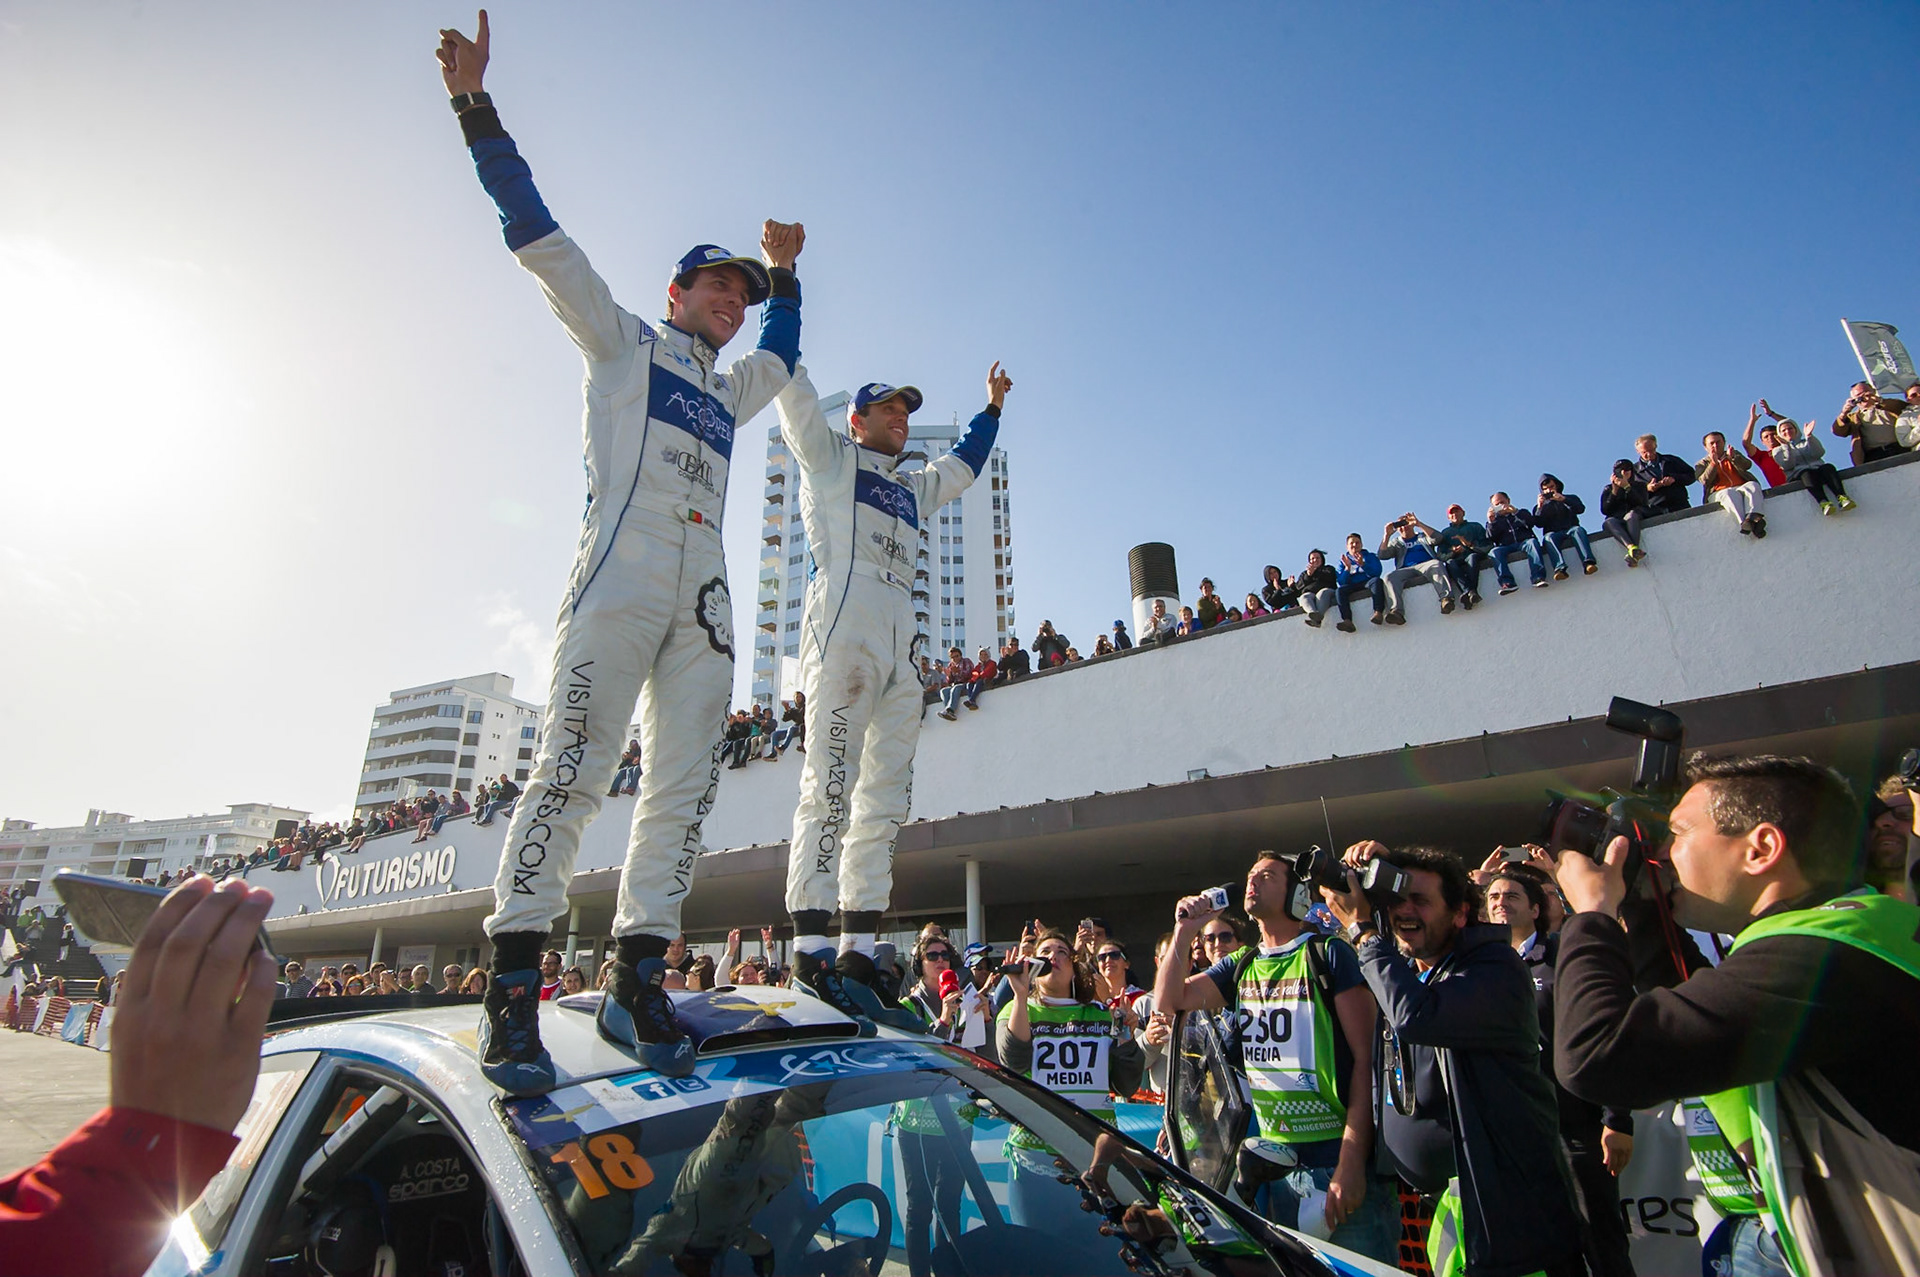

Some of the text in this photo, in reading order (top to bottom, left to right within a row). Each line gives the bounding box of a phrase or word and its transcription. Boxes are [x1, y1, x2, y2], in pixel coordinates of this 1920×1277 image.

[665, 392, 732, 442] AÇORES
[870, 486, 914, 518] AÇORES
[334, 845, 456, 900] FUTURISMO
[1053, 1022, 1084, 1034] airlines
[1086, 1022, 1110, 1035] rallye
[1240, 1008, 1291, 1044] 250
[1037, 1041, 1098, 1070] 207
[1245, 1047, 1281, 1062] MEDIA
[1047, 1072, 1093, 1085] MEDIA
[1292, 1121, 1342, 1132] DANGEROUS
[414, 1158, 461, 1178] COSTA
[550, 1133, 655, 1200] 18
[388, 1174, 470, 1201] sparco
[1620, 1197, 1700, 1237] res
